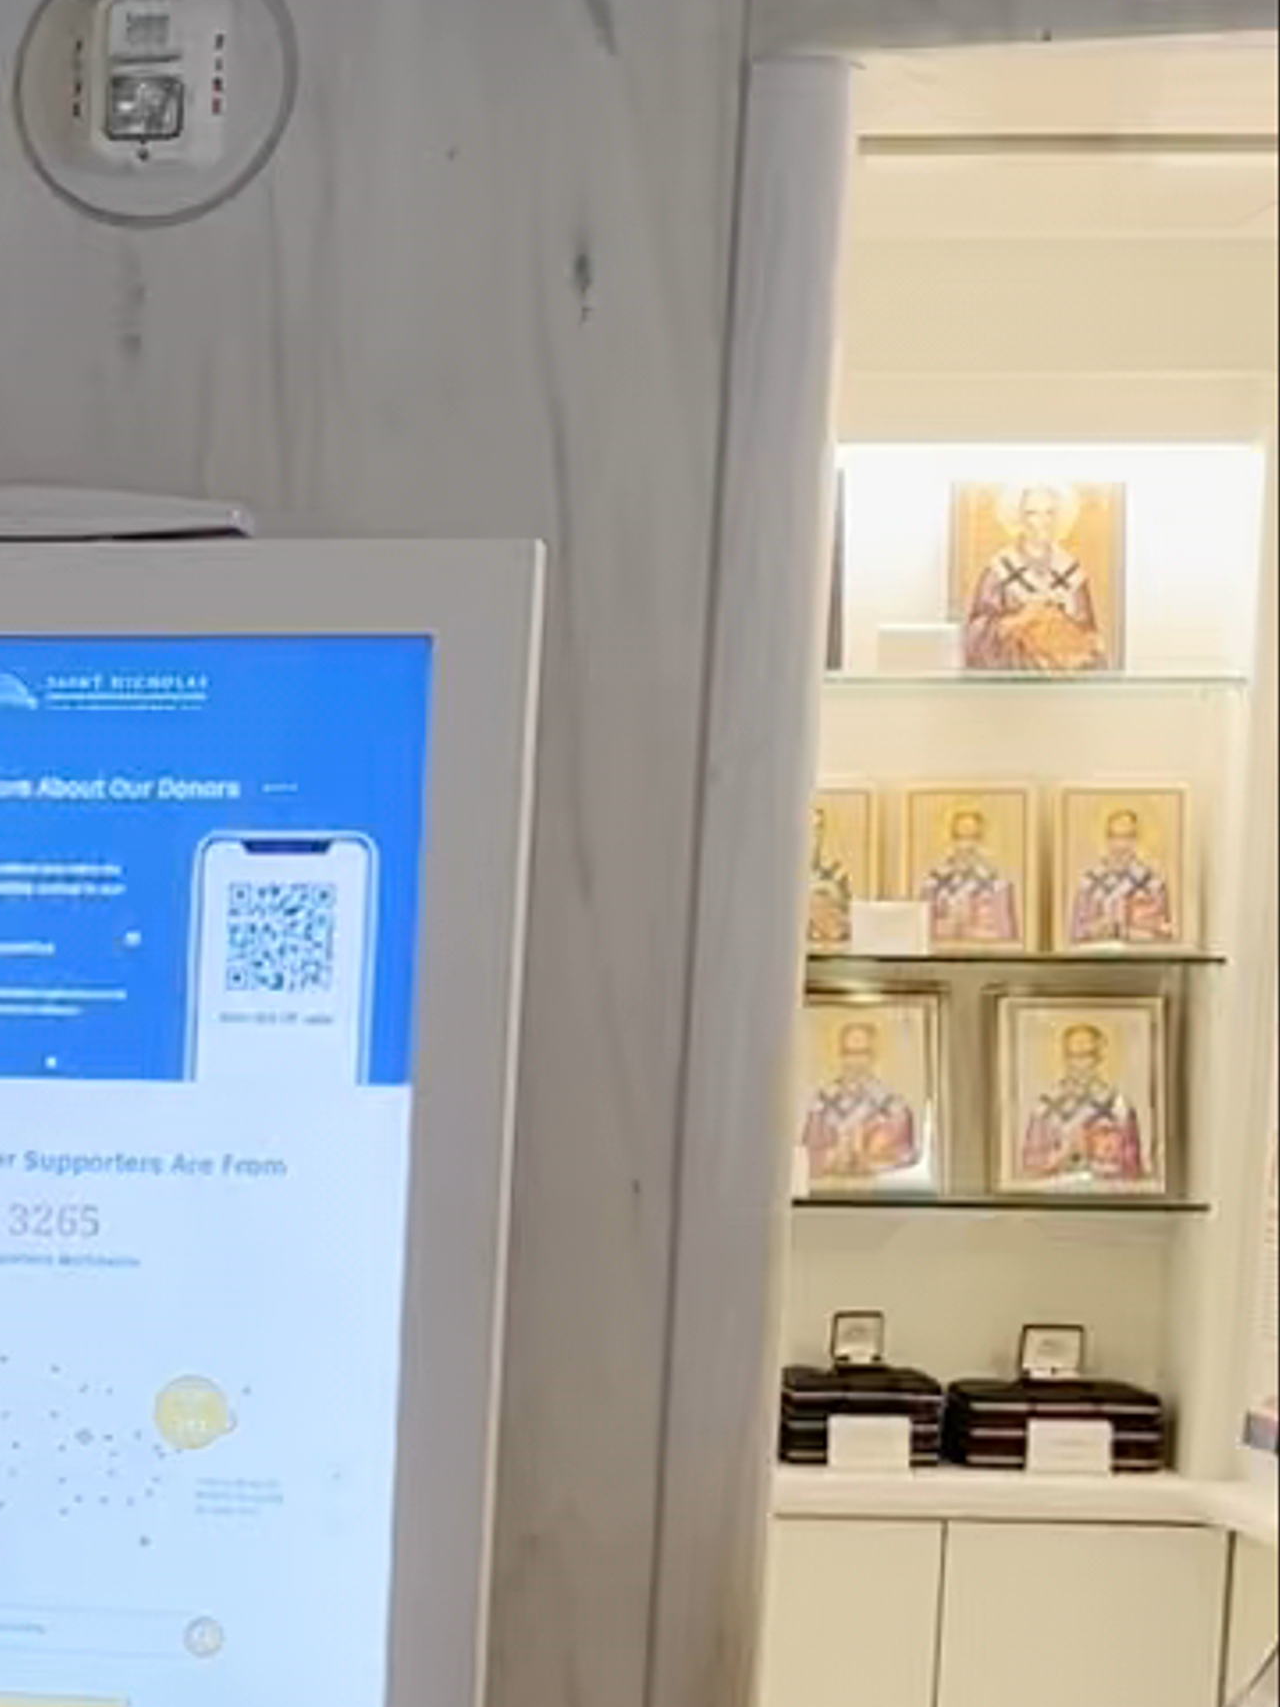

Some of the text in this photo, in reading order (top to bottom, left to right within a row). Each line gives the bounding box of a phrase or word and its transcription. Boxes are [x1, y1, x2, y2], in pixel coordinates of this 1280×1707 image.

[37, 776, 106, 800] About
[109, 777, 154, 800] Our
[157, 777, 240, 801] Donors
[23, 1150, 164, 1176] Supporters
[171, 1153, 213, 1176] Are
[221, 1153, 288, 1176] From
[8, 1203, 100, 1237] 3265
